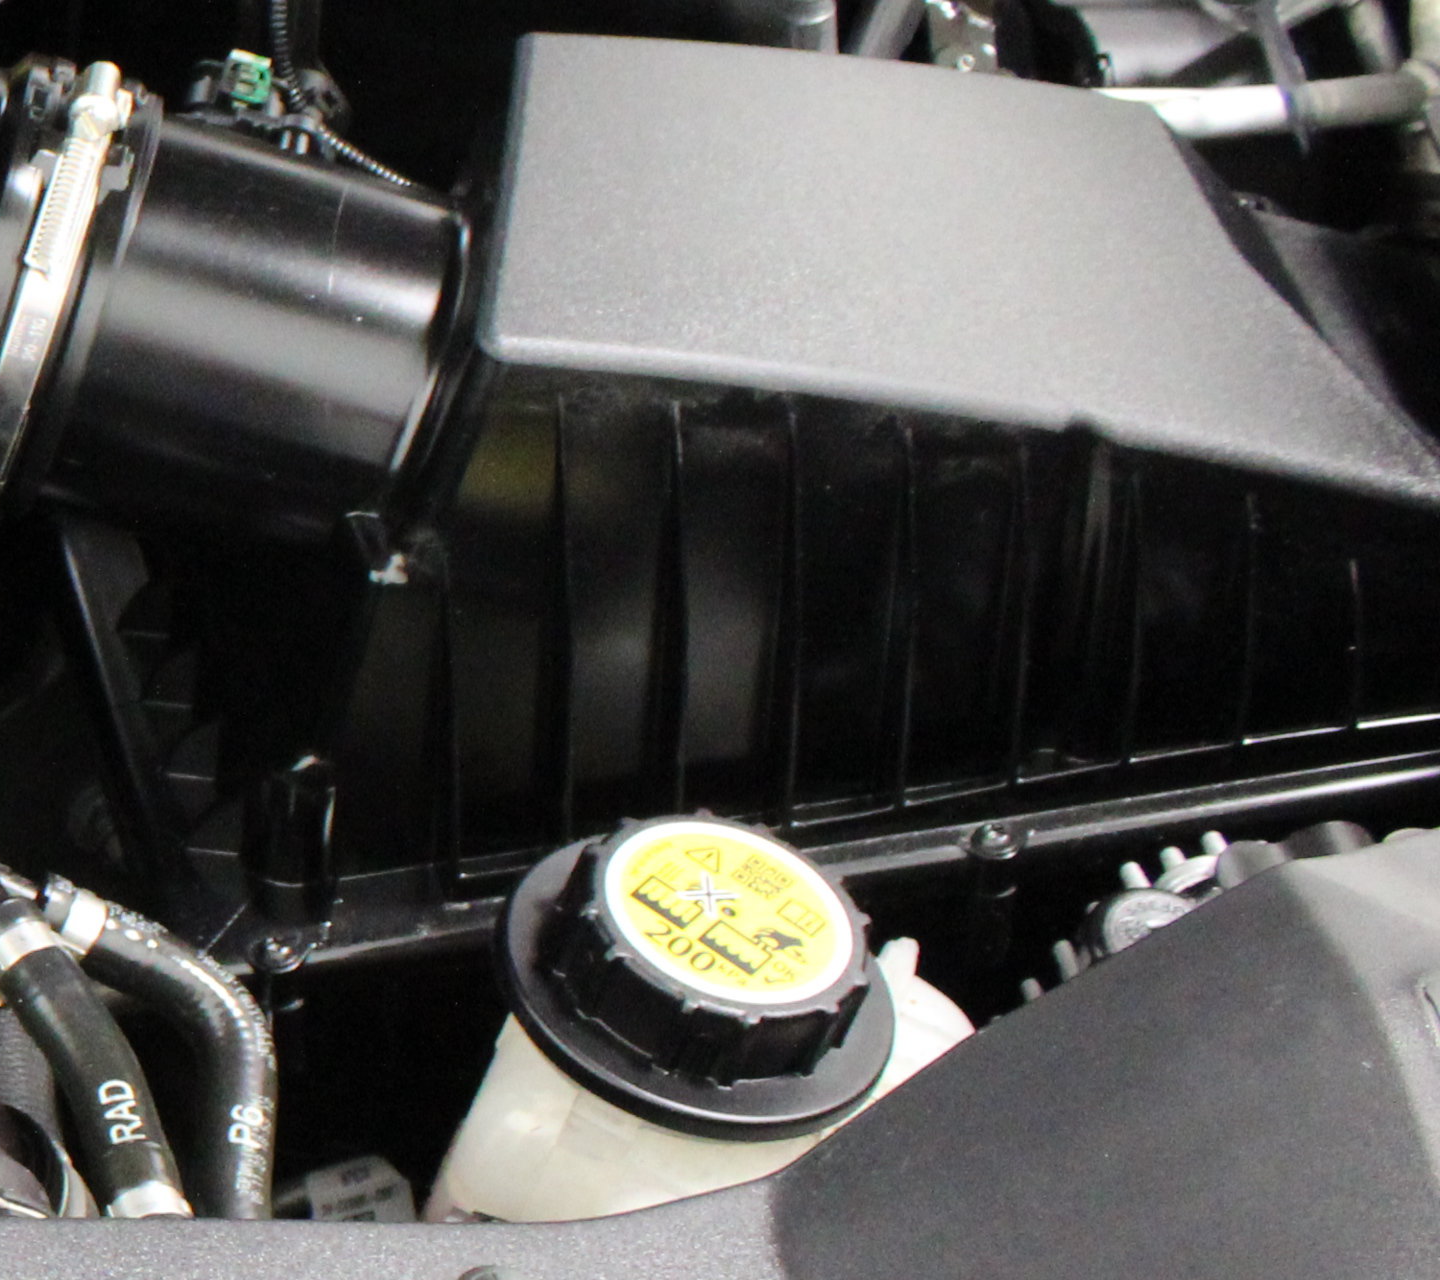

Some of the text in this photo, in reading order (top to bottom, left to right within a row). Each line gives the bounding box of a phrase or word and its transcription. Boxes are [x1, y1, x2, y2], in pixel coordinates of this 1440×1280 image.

[643, 920, 716, 972] 200
[97, 1078, 147, 1146] RAD
[227, 1103, 265, 1150] P6
